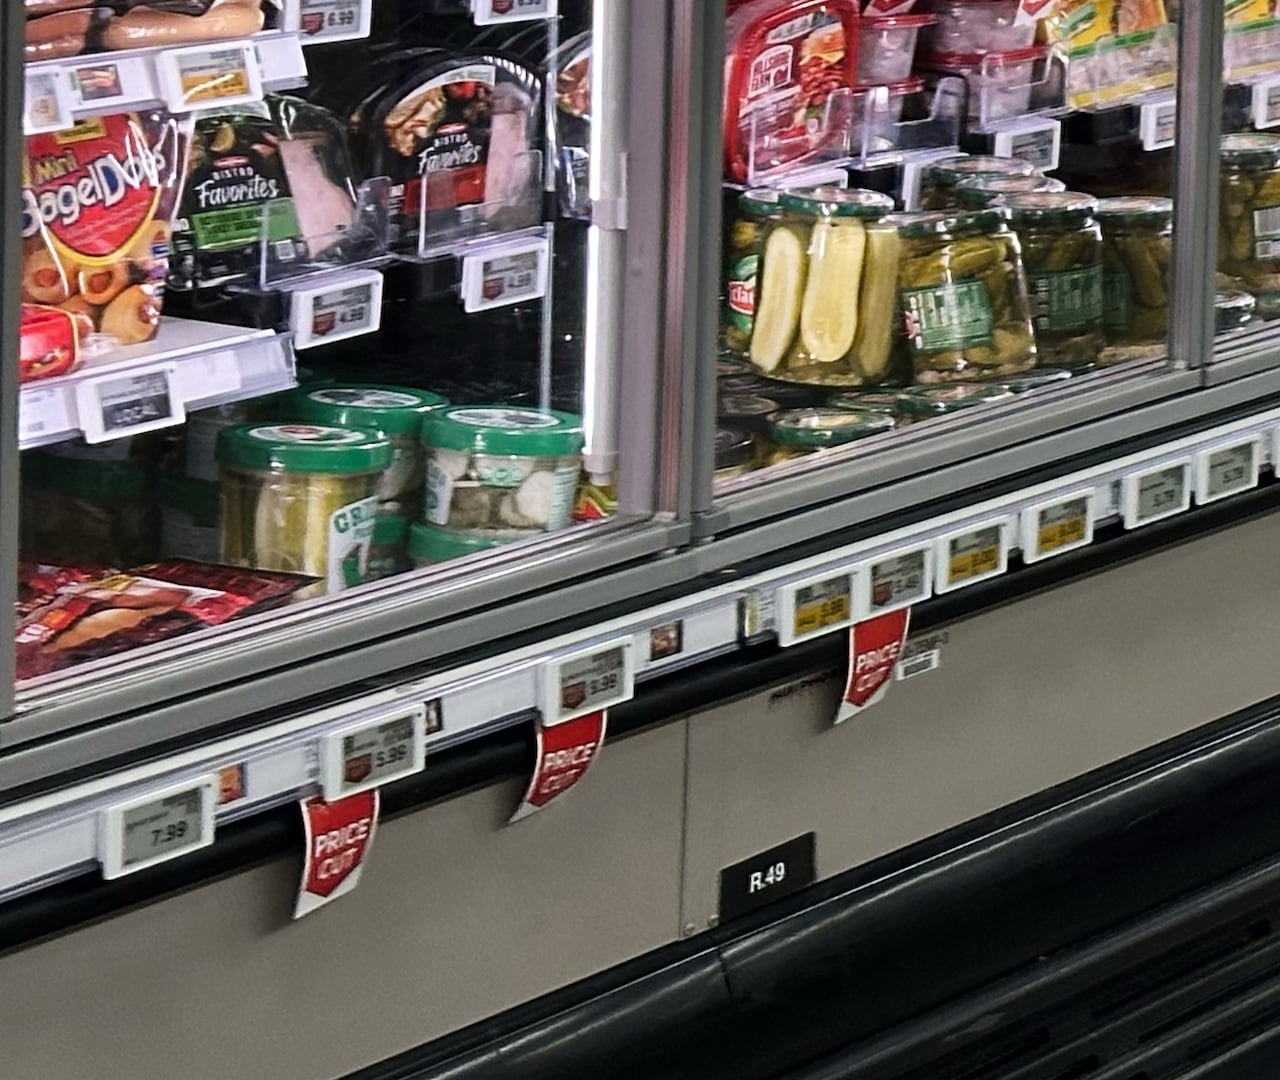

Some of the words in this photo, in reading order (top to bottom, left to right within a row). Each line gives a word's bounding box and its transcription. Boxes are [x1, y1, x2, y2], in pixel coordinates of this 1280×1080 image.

[211, 166, 253, 179] BISTRO
[418, 143, 481, 174] Favorites
[194, 176, 279, 208] Favorites
[856, 640, 900, 670] PRICE
[543, 742, 598, 772] PRICE
[541, 766, 580, 795] CUT
[315, 818, 369, 854] PRICE
[317, 847, 359, 880] CUT
[747, 862, 786, 894] R.49
